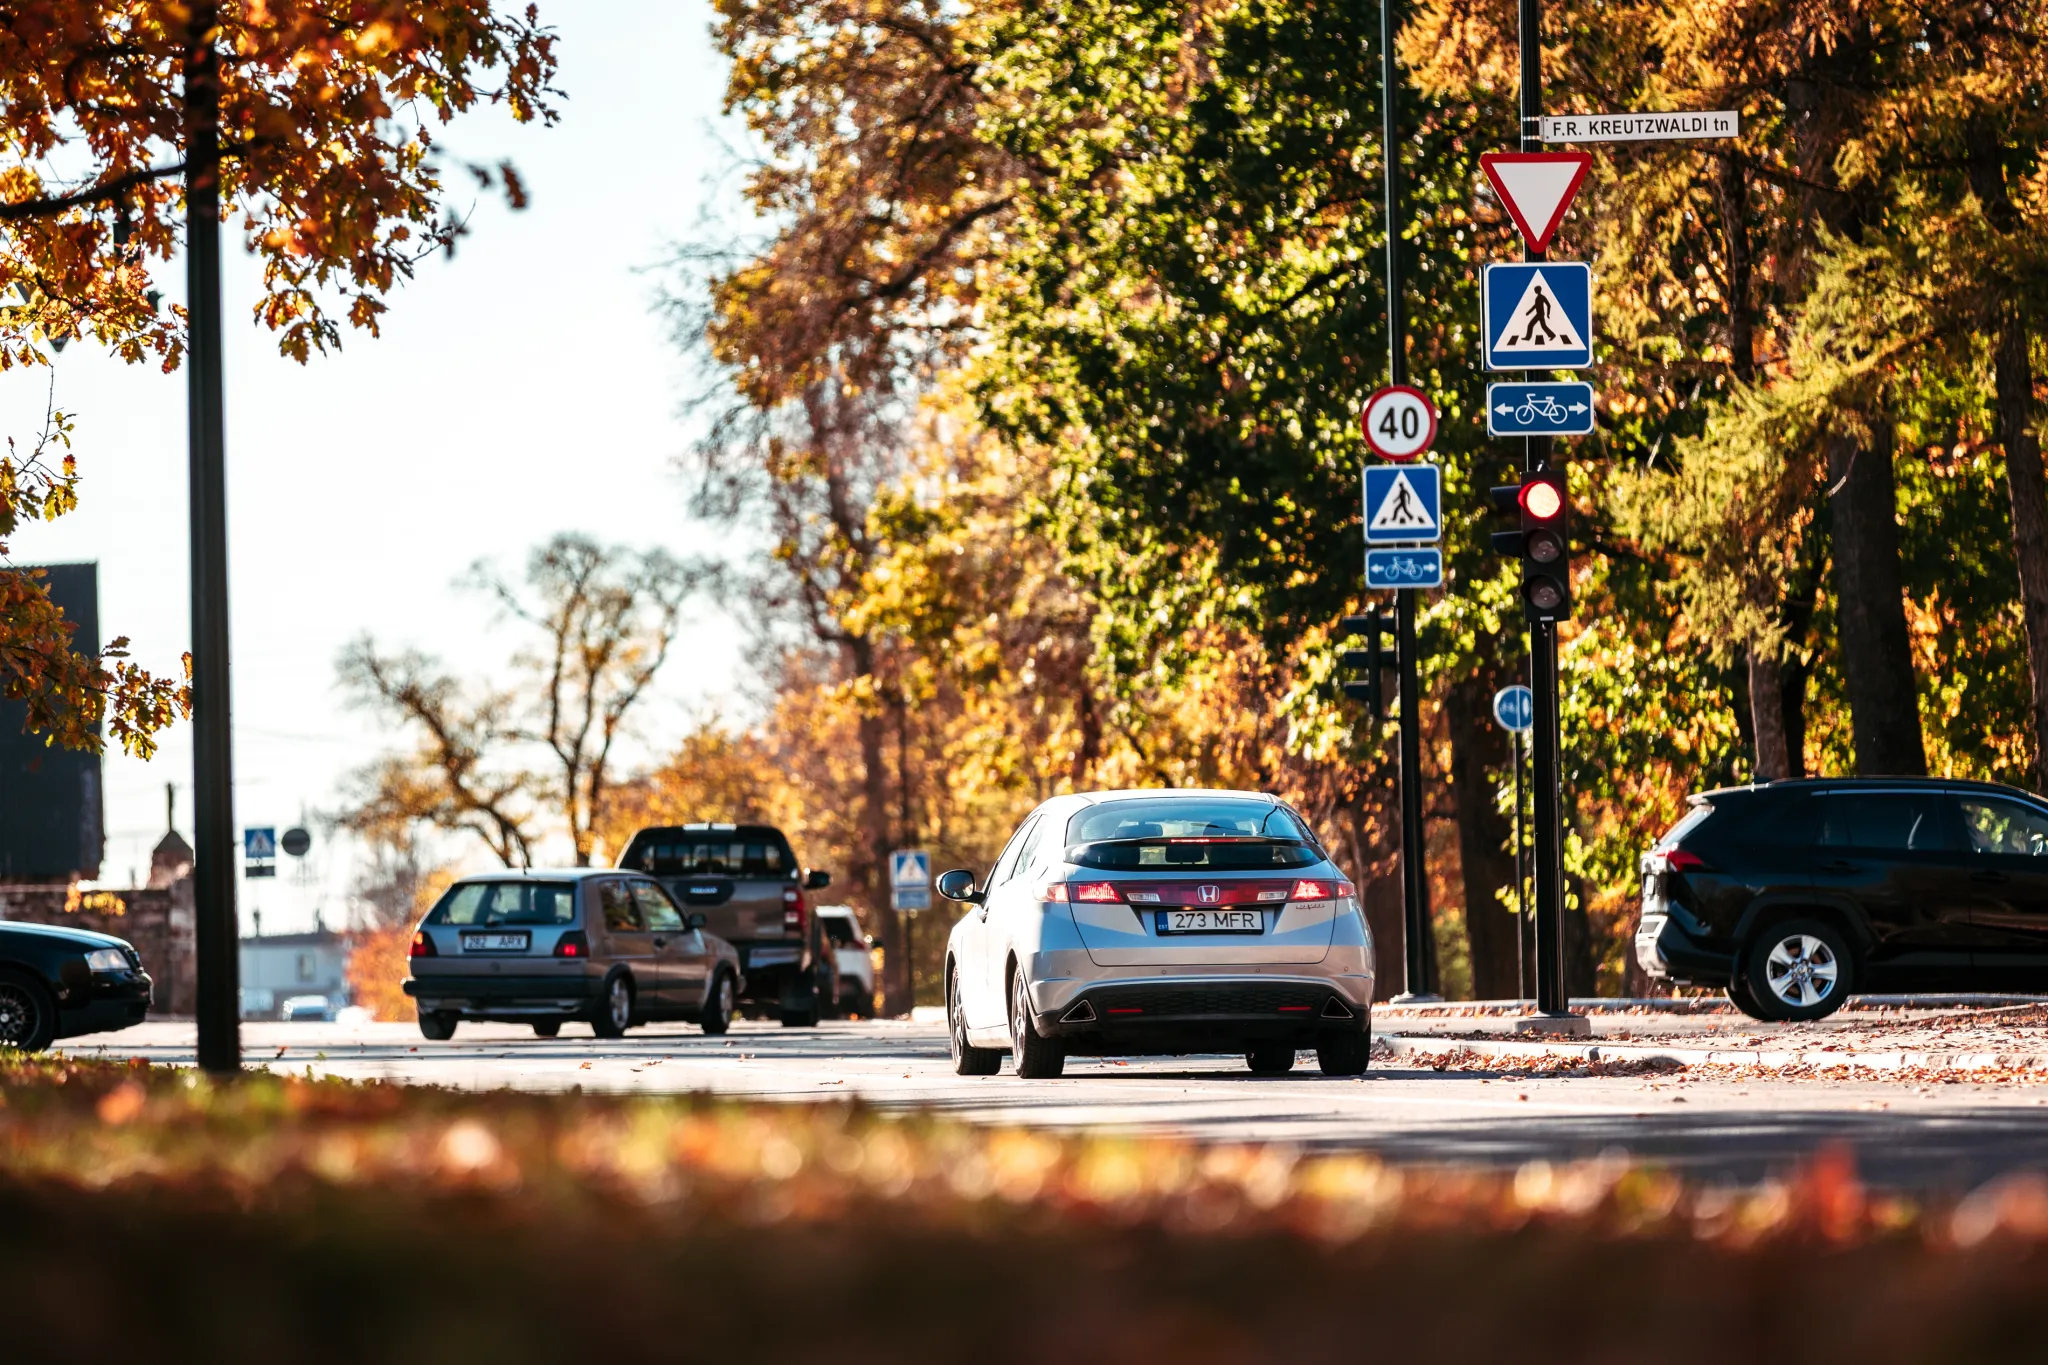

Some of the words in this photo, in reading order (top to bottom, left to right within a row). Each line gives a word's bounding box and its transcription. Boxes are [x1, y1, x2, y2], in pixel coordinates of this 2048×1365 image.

[1553, 122, 1582, 136] F.R.
[1589, 117, 1707, 135] KREUTZWALDI
[1713, 118, 1729, 132] tn
[1379, 406, 1419, 439] 40
[1175, 913, 1206, 928] 273
[1214, 912, 1255, 928] MFR
